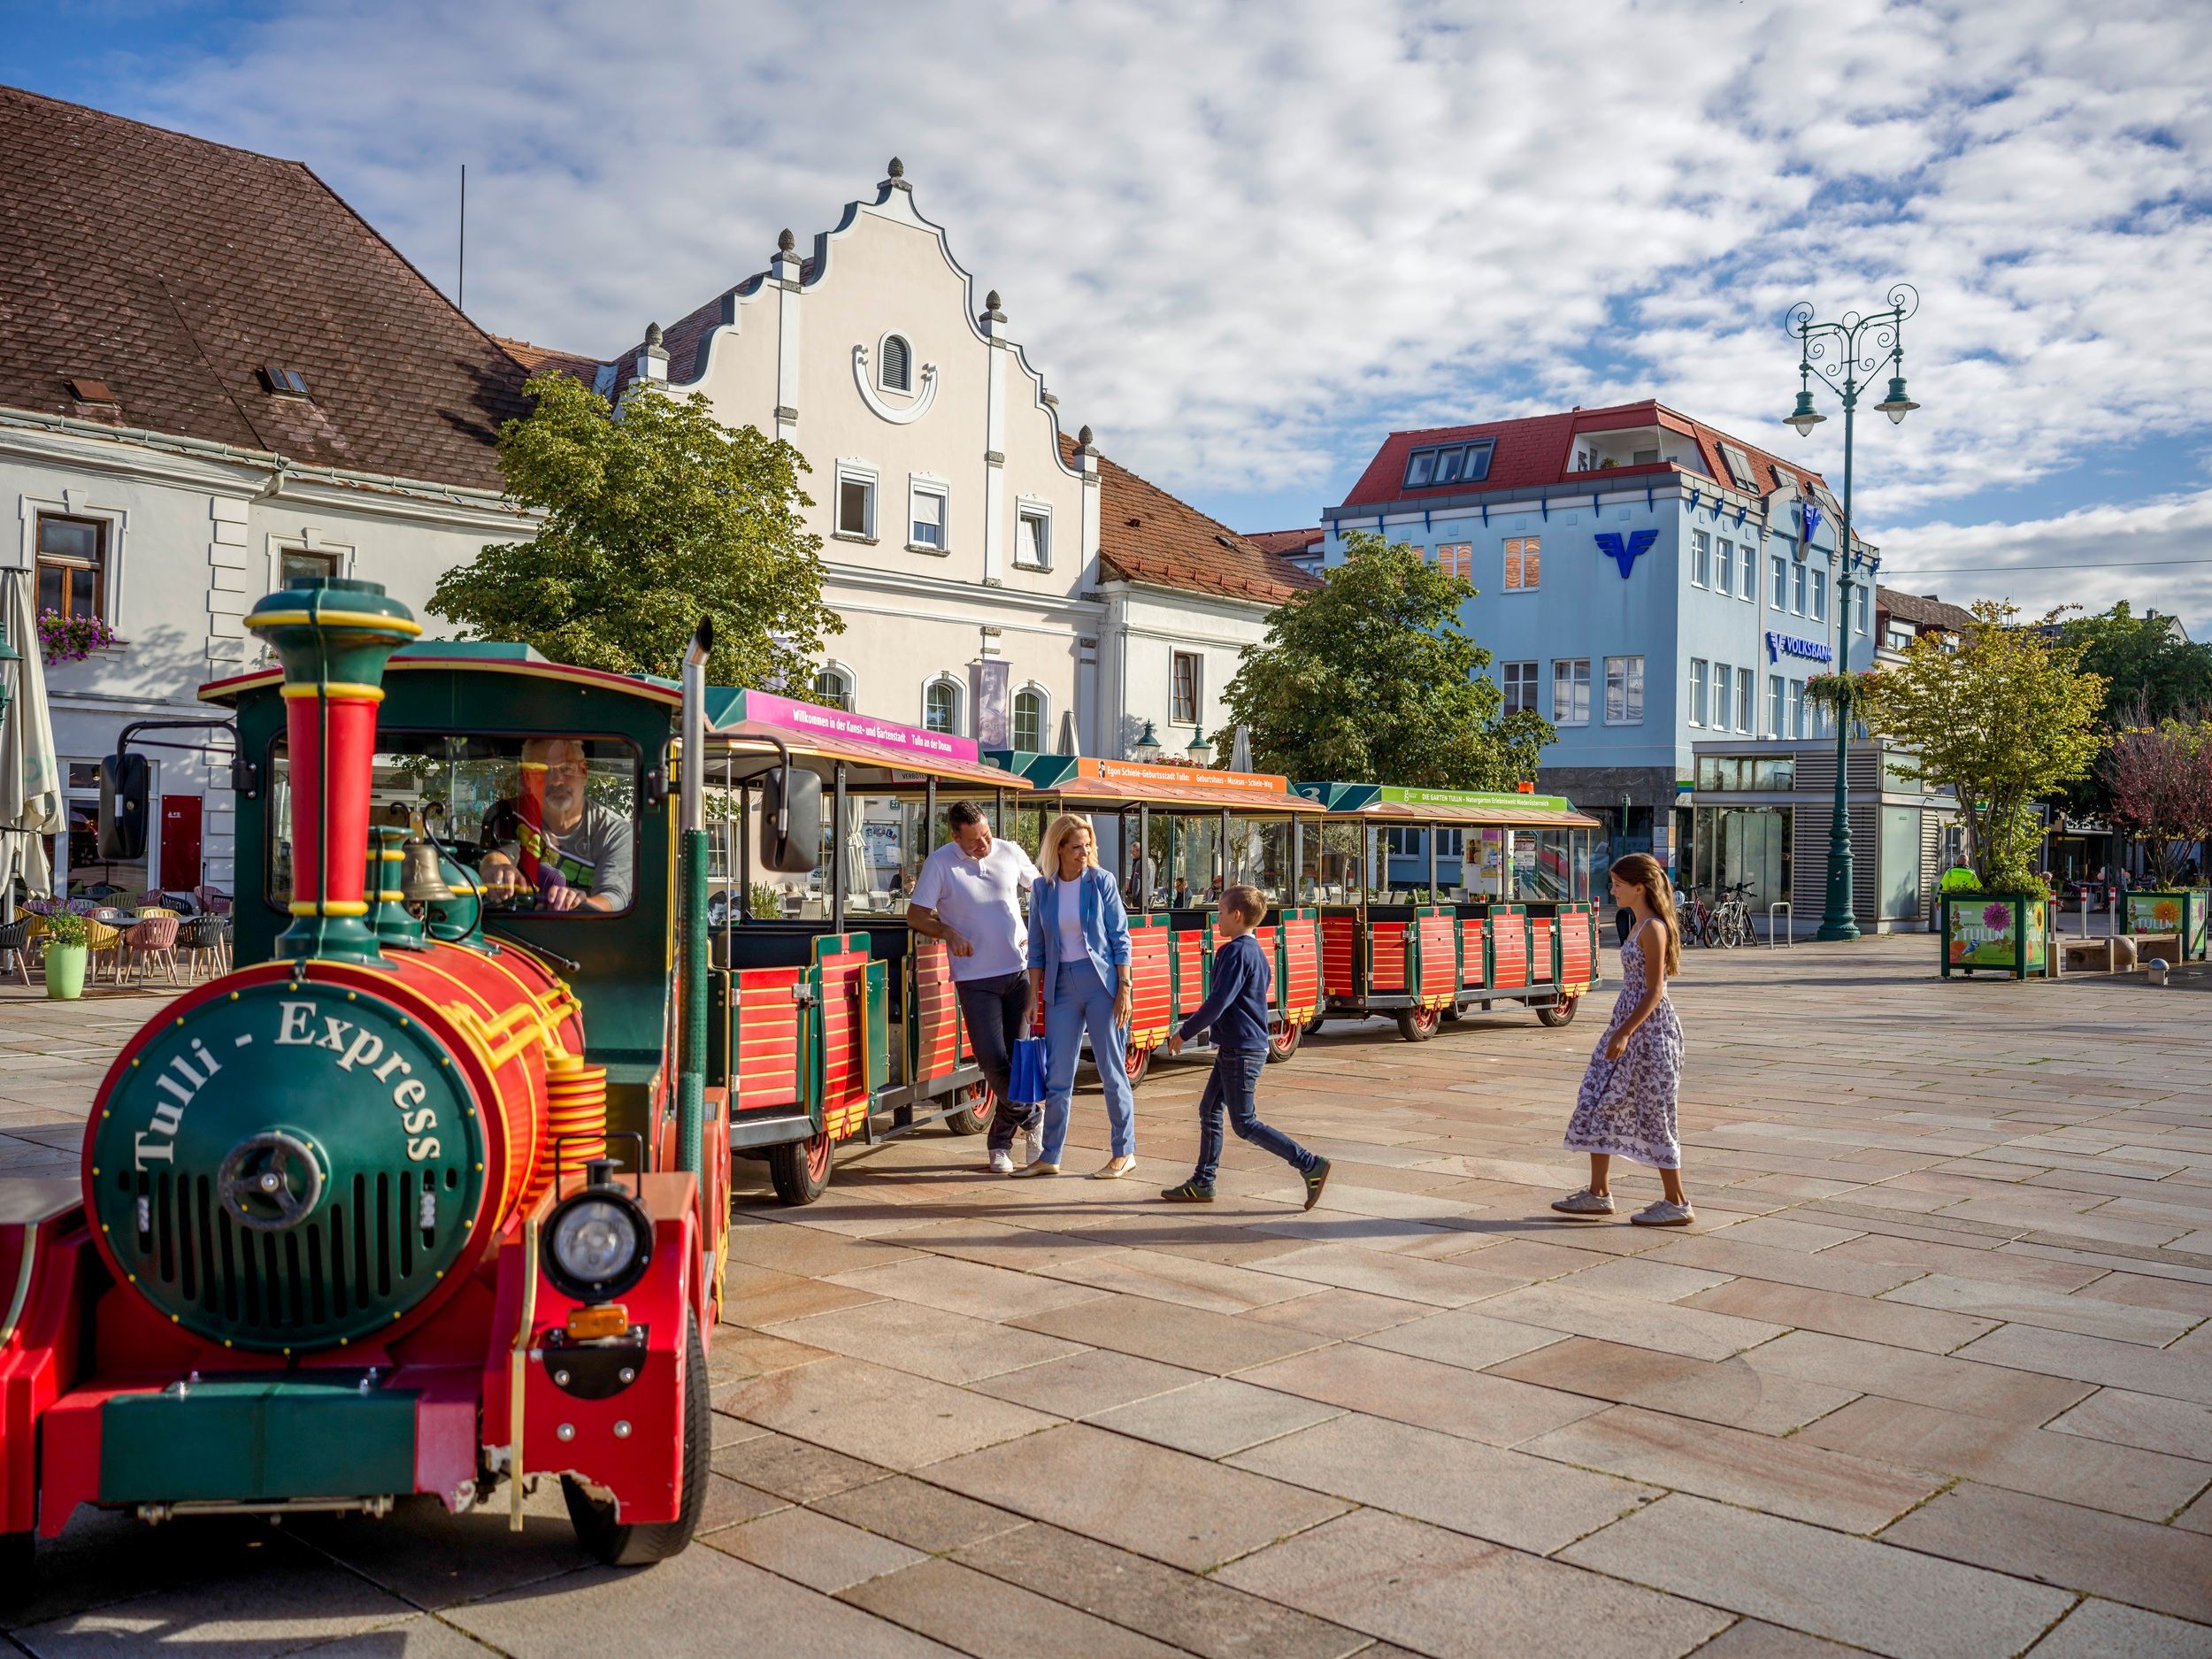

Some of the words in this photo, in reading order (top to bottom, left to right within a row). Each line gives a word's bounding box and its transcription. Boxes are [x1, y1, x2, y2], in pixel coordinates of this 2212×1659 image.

[1787, 636, 1832, 662] VOLKSBANK
[793, 709, 829, 726] Willkommen
[829, 717, 835, 728] in
[836, 718, 846, 731] der
[846, 721, 865, 734] Kunst-
[865, 725, 876, 737] und
[877, 726, 907, 743] Gartenstadt
[911, 734, 924, 746] Tulln
[924, 739, 930, 748] an
[938, 741, 952, 752] Donau
[1107, 766, 1121, 777] Egon
[1122, 767, 1176, 780] Schiele-Geburtsstadt
[1196, 773, 1224, 785] Geburtshaus
[1227, 777, 1245, 786] Museum
[1248, 779, 1272, 789] Schiele-Weg
[1465, 796, 1491, 805] Naturgarten
[1962, 927, 2004, 941] TULLN
[2137, 918, 2173, 930] TULLN
[134, 1037, 223, 1172] Tulli
[234, 1033, 253, 1048] -
[273, 1001, 442, 1162] Express
